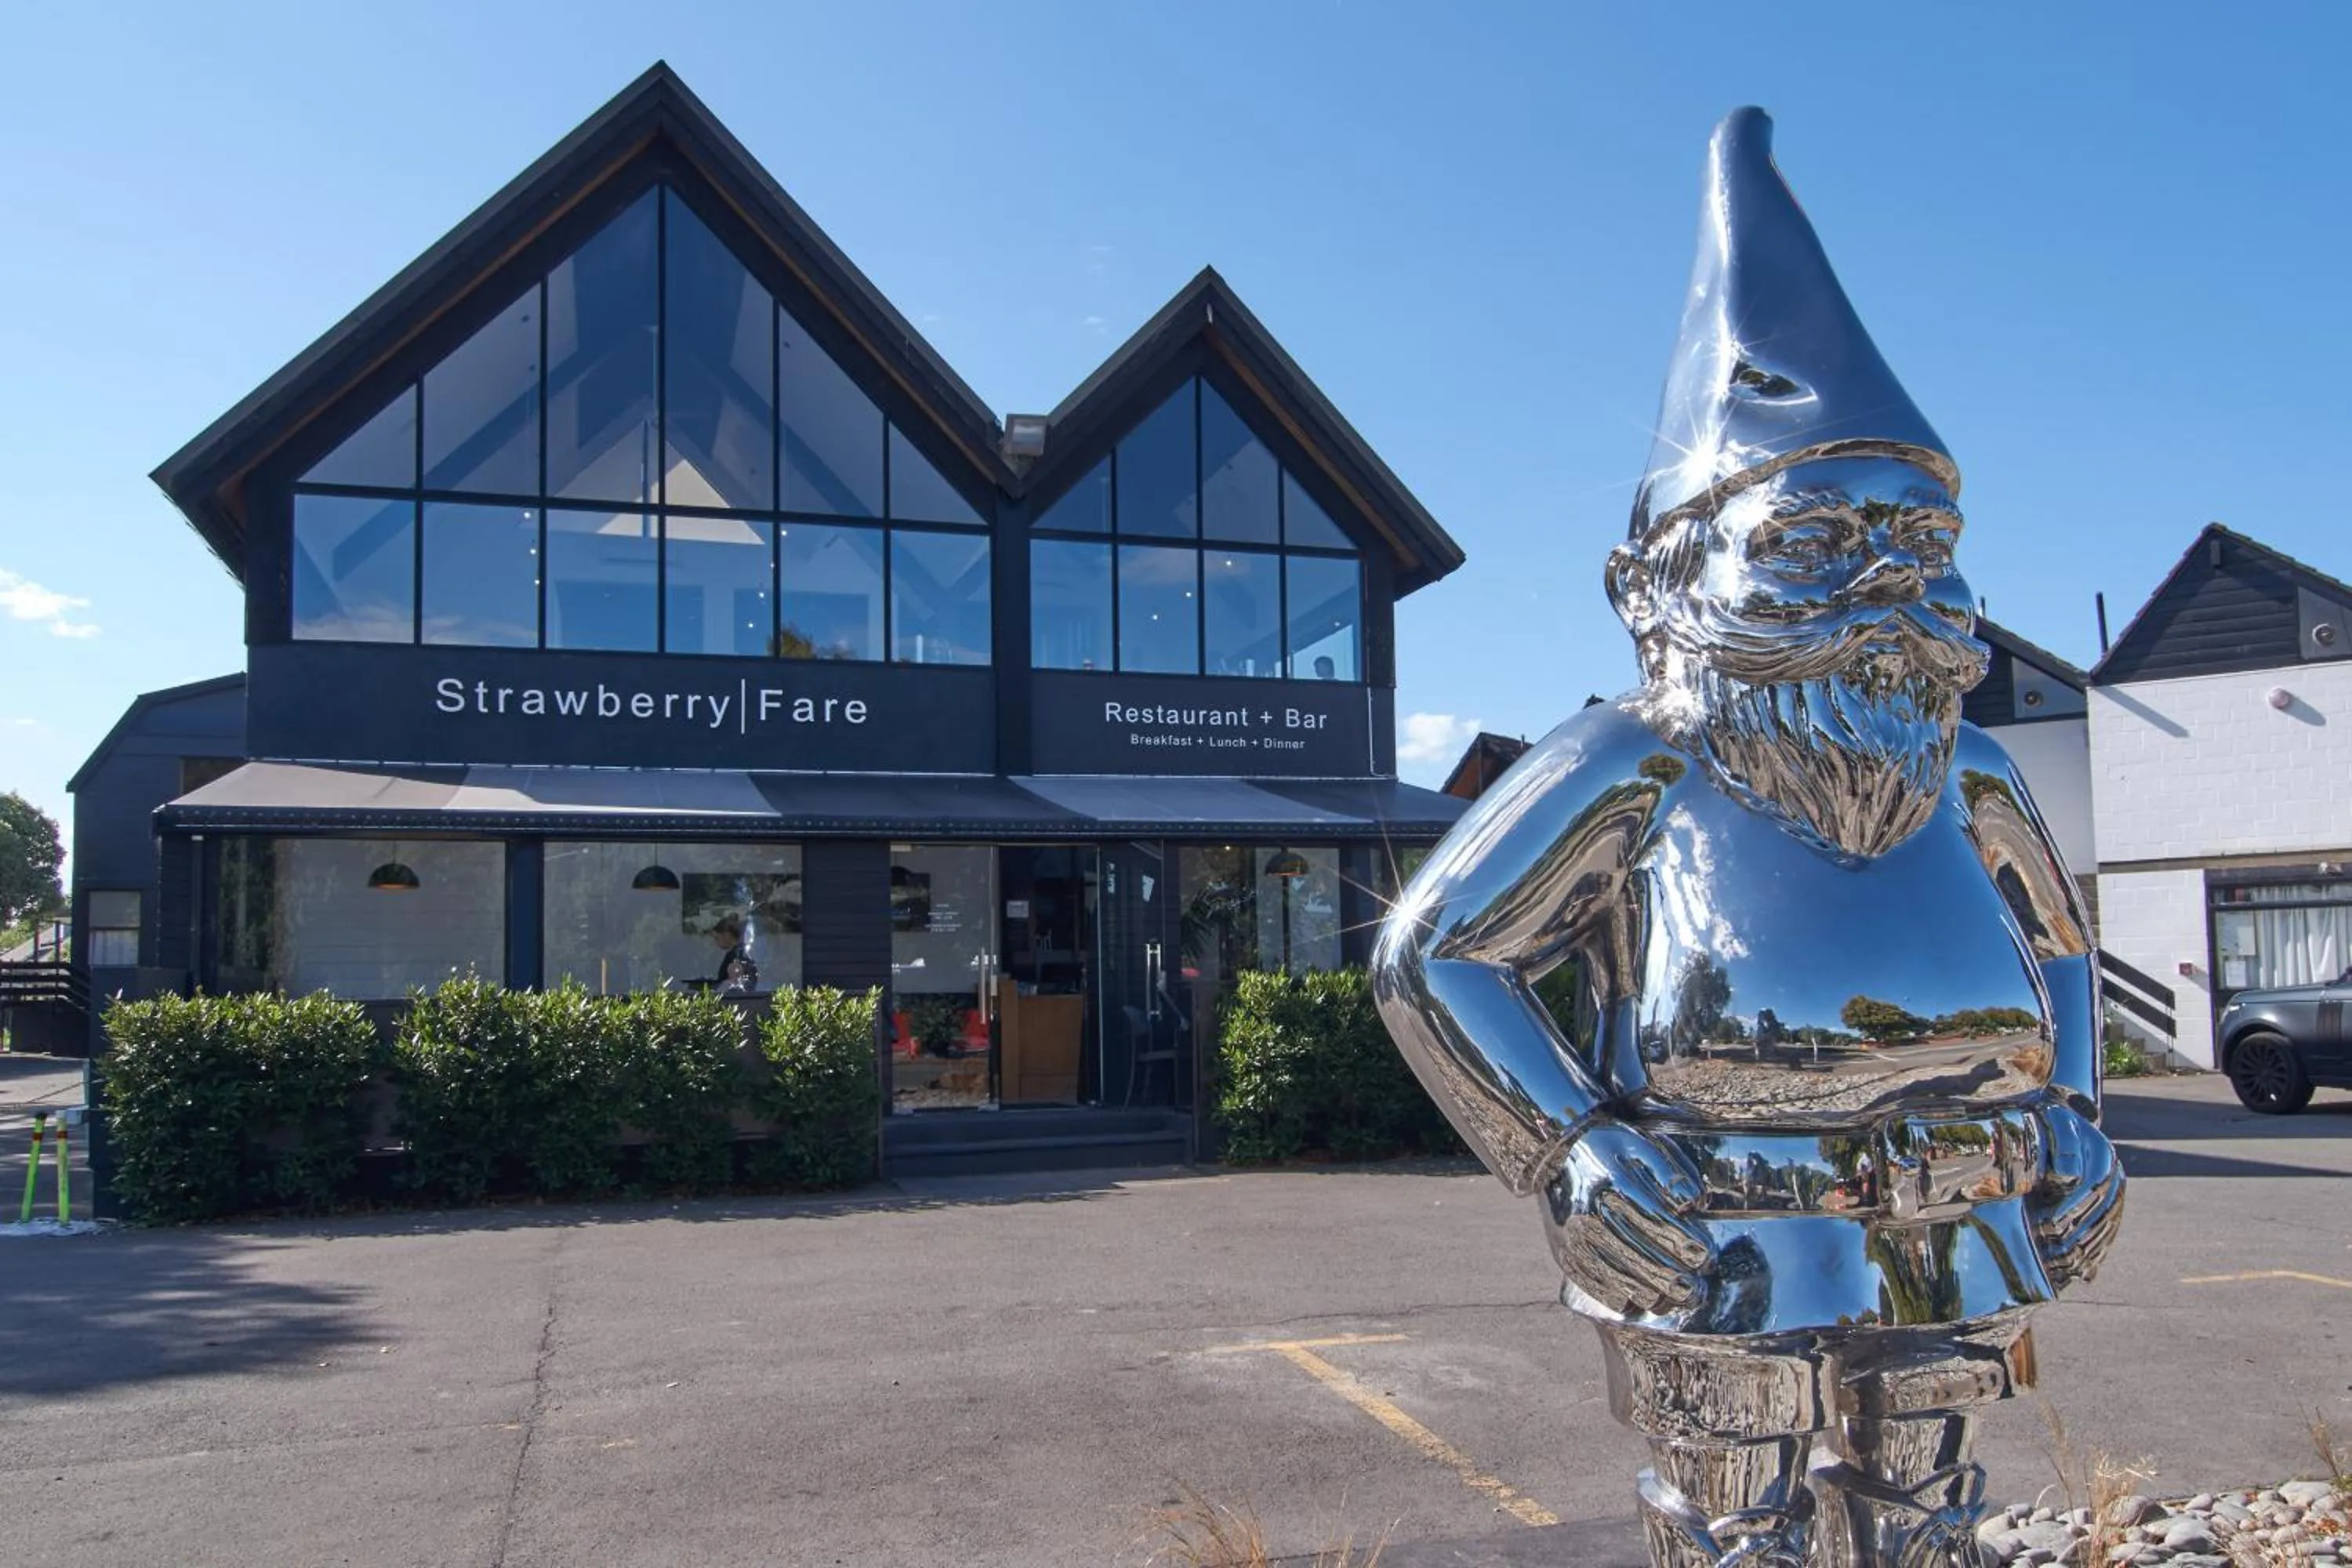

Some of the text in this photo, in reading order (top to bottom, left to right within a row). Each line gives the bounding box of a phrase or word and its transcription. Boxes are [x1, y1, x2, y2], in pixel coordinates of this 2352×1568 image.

[436, 678, 867, 728] Strawberry Fare
[1105, 702, 1249, 727] Restaurant
[1284, 708, 1327, 728] Bar
[1130, 733, 1192, 746] Breakfast
[1209, 736, 1247, 747] Lunch
[1263, 738, 1305, 750] Dinner
